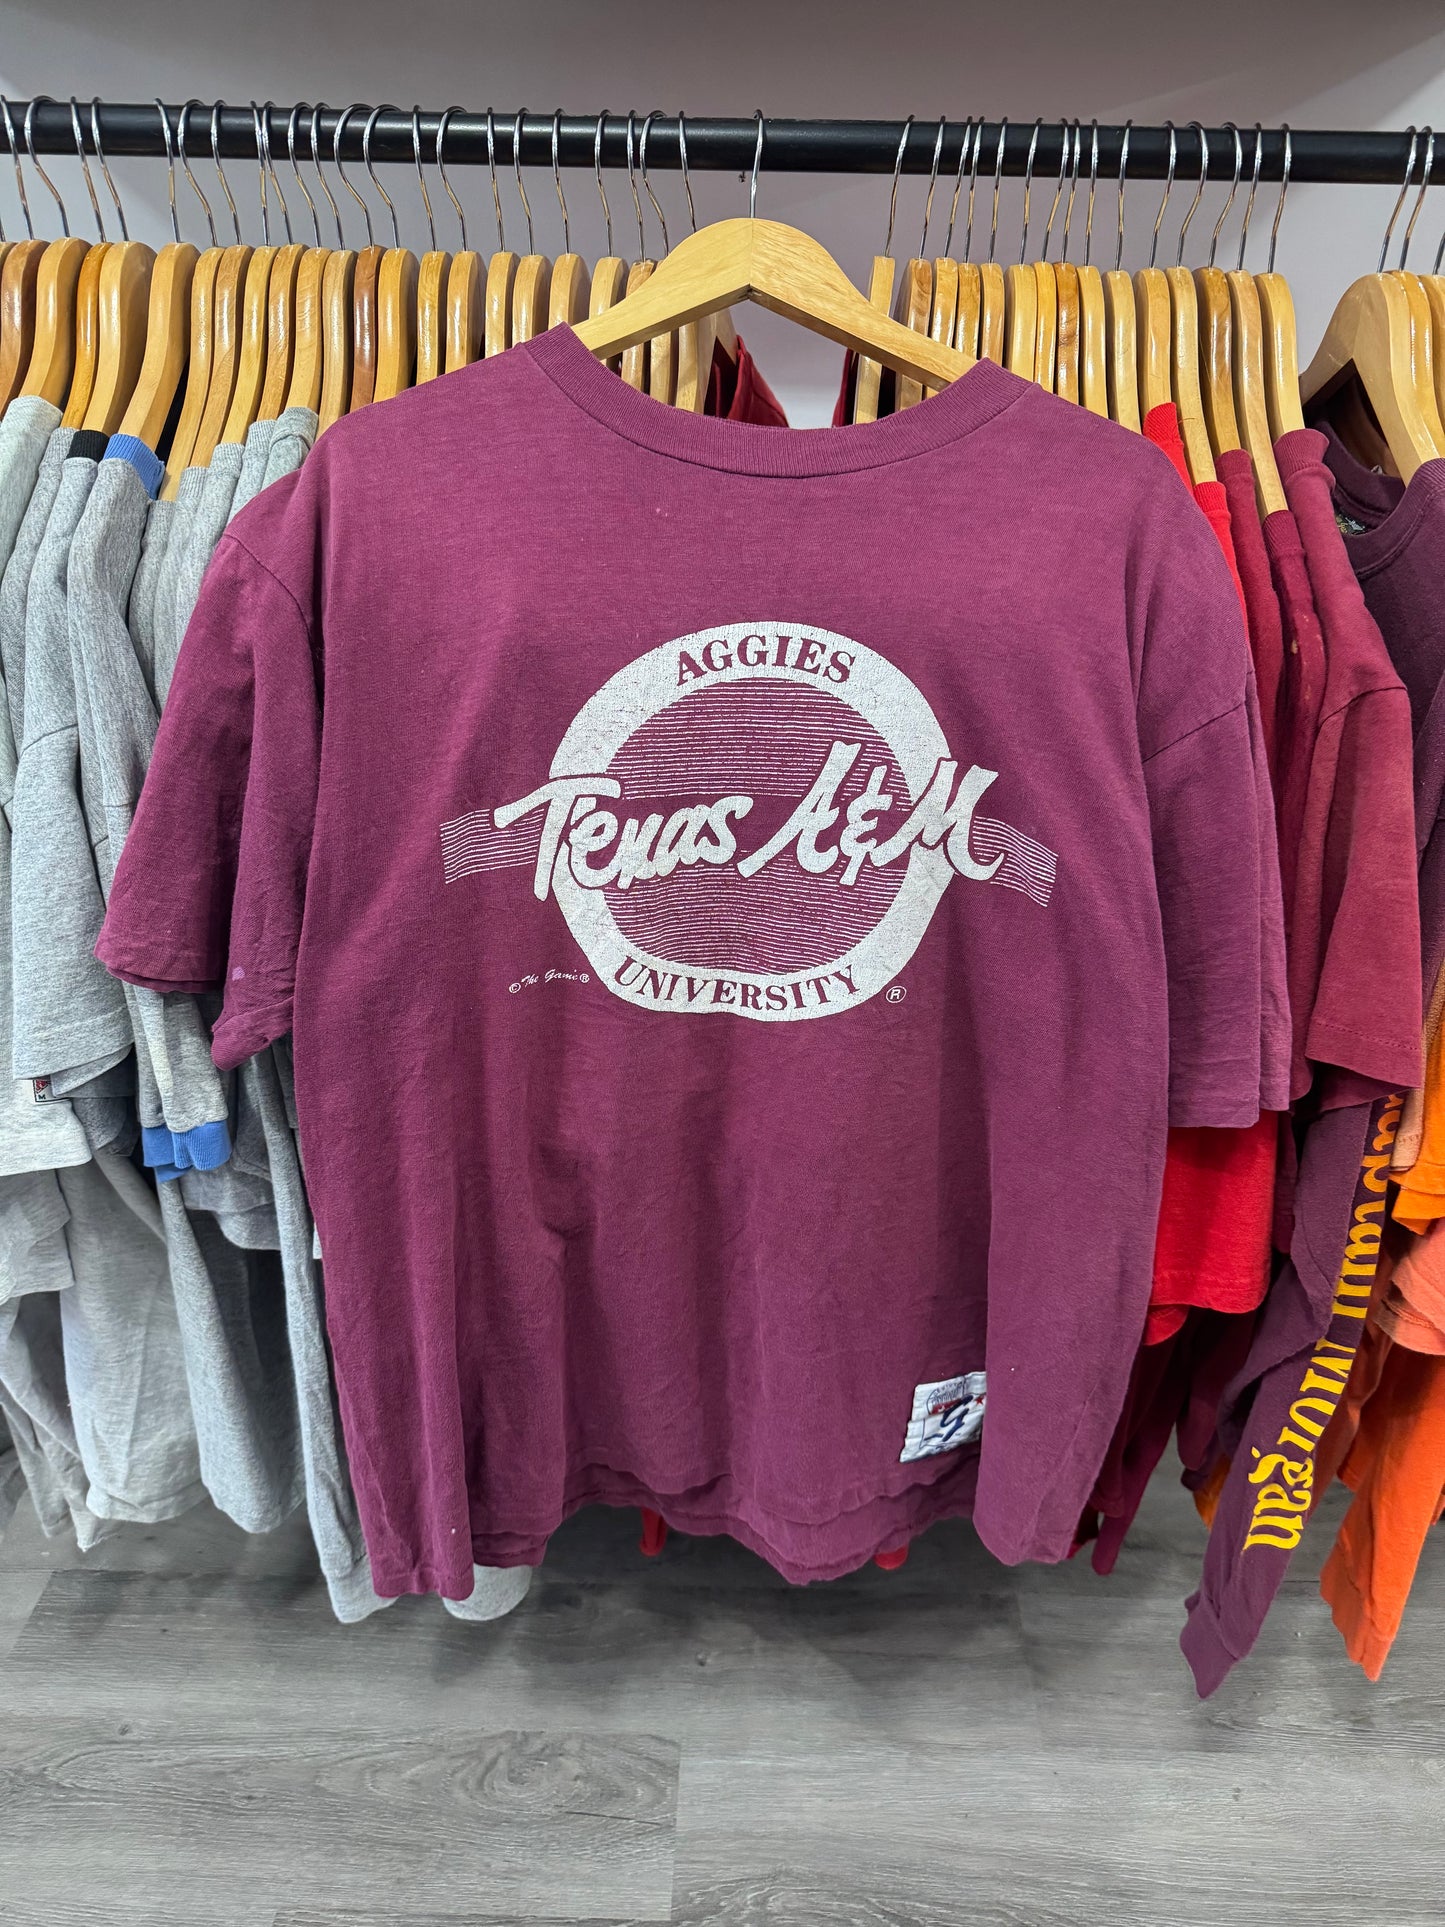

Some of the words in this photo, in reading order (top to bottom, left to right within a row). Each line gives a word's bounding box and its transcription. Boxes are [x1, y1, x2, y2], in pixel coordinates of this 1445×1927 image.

[676, 635, 856, 686] AGGIES
[495, 774, 753, 901] Texas
[737, 741, 1004, 886] A&M
[612, 956, 860, 1011] UNIVERSITY
[1242, 1336, 1357, 1552] Morgan
